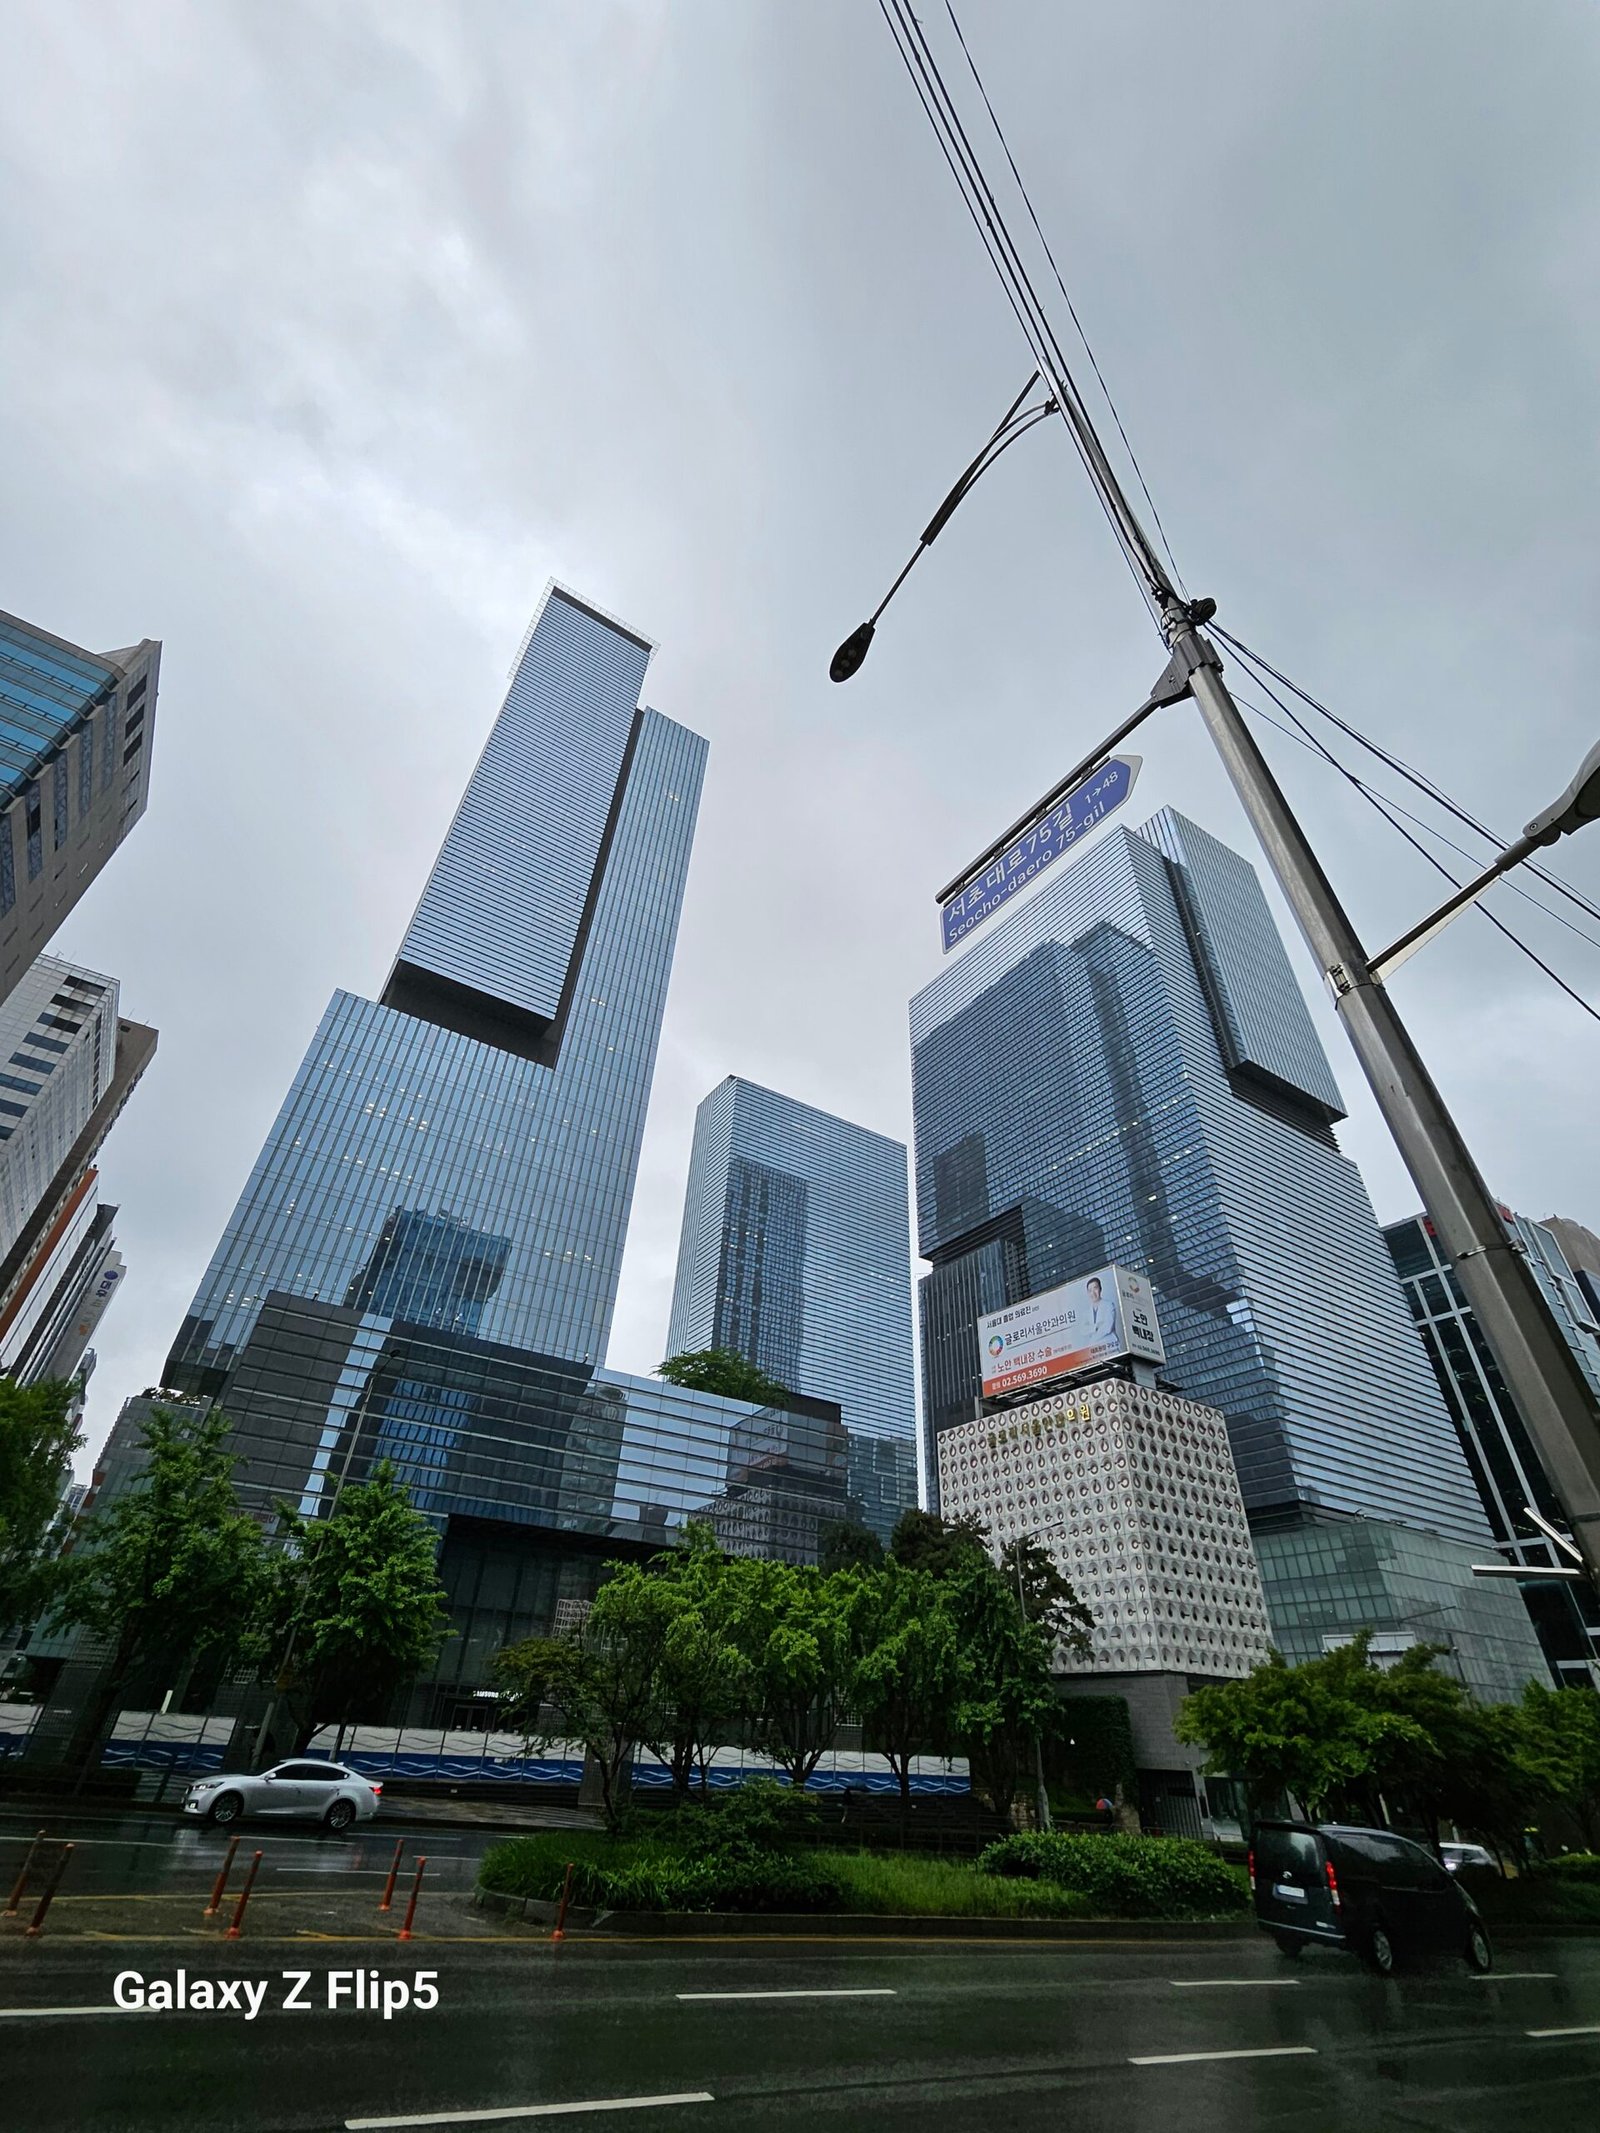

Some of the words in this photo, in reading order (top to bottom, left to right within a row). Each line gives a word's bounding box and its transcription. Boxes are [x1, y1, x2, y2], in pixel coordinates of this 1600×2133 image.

[1102, 771, 1119, 789] 48
[949, 802, 1075, 922] 서초대로75길
[949, 850, 1053, 943] Seocho-daero
[1056, 801, 1106, 850] 75-gil
[1015, 1306, 1032, 1318] 의료진
[1133, 1310, 1148, 1326] 노안
[1004, 1310, 1076, 1346] 글로리서울안과의원
[1132, 1325, 1154, 1342] 백내장
[997, 1359, 1012, 1373] 노안
[1013, 1352, 1035, 1366] 백내장
[1002, 1366, 1048, 1388] 02.569.3690
[472, 1690, 499, 1698] SAMSUNG
